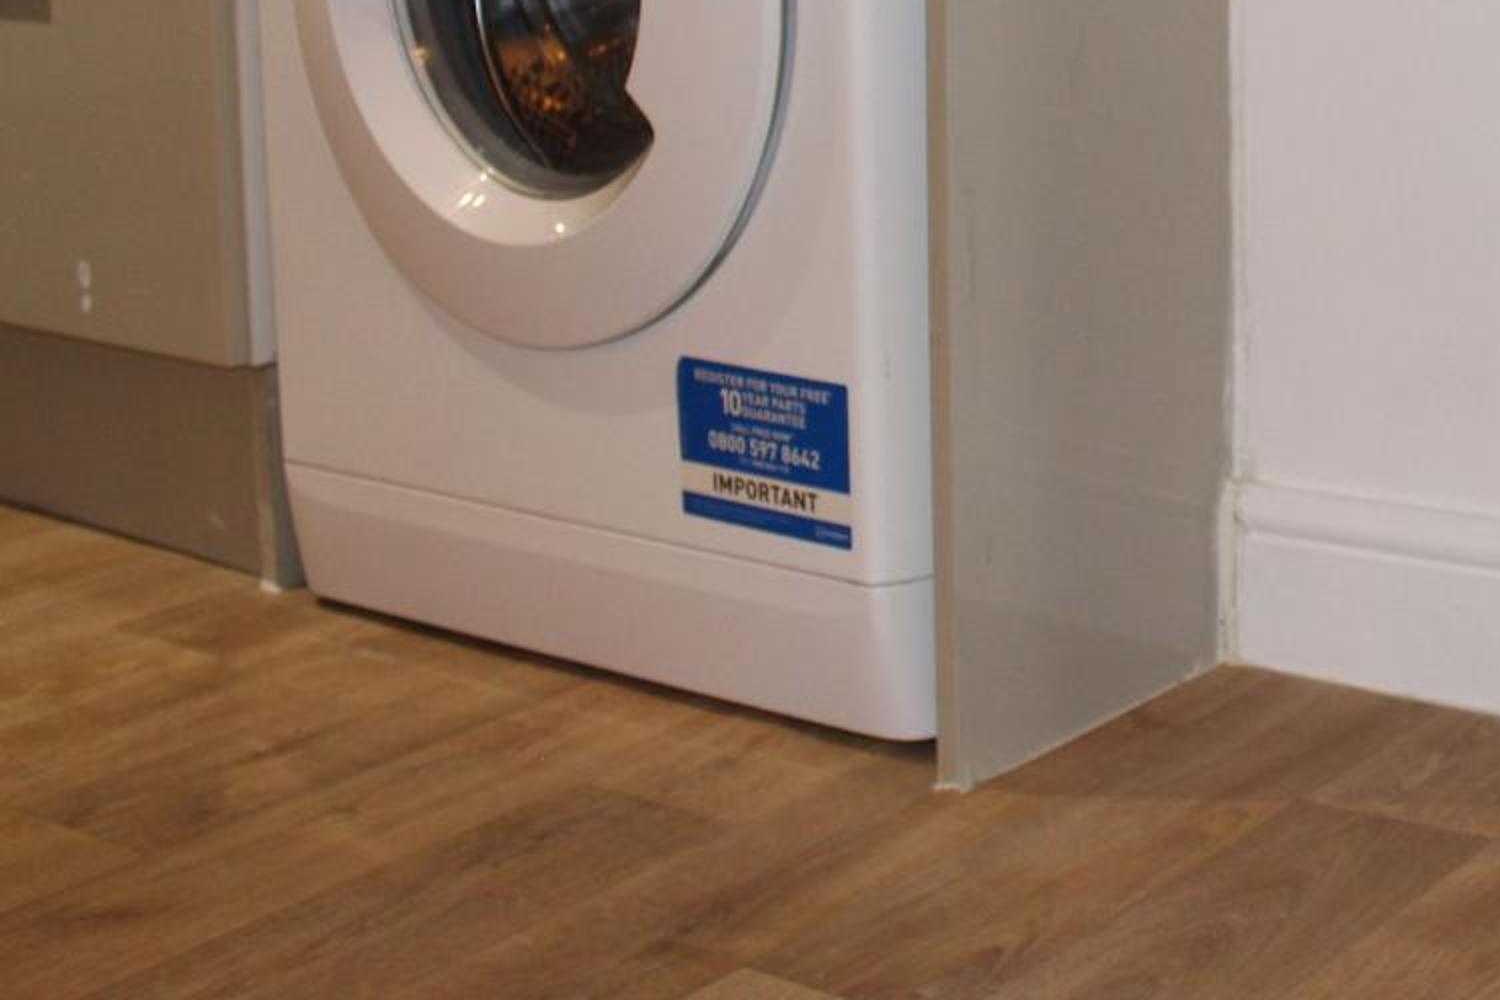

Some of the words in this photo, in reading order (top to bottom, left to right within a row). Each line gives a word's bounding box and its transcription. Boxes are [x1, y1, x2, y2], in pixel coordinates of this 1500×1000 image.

[720, 388, 742, 417] 10
[708, 428, 746, 455] 0800
[749, 436, 778, 461] 597
[712, 471, 819, 513] IMPORTANT
